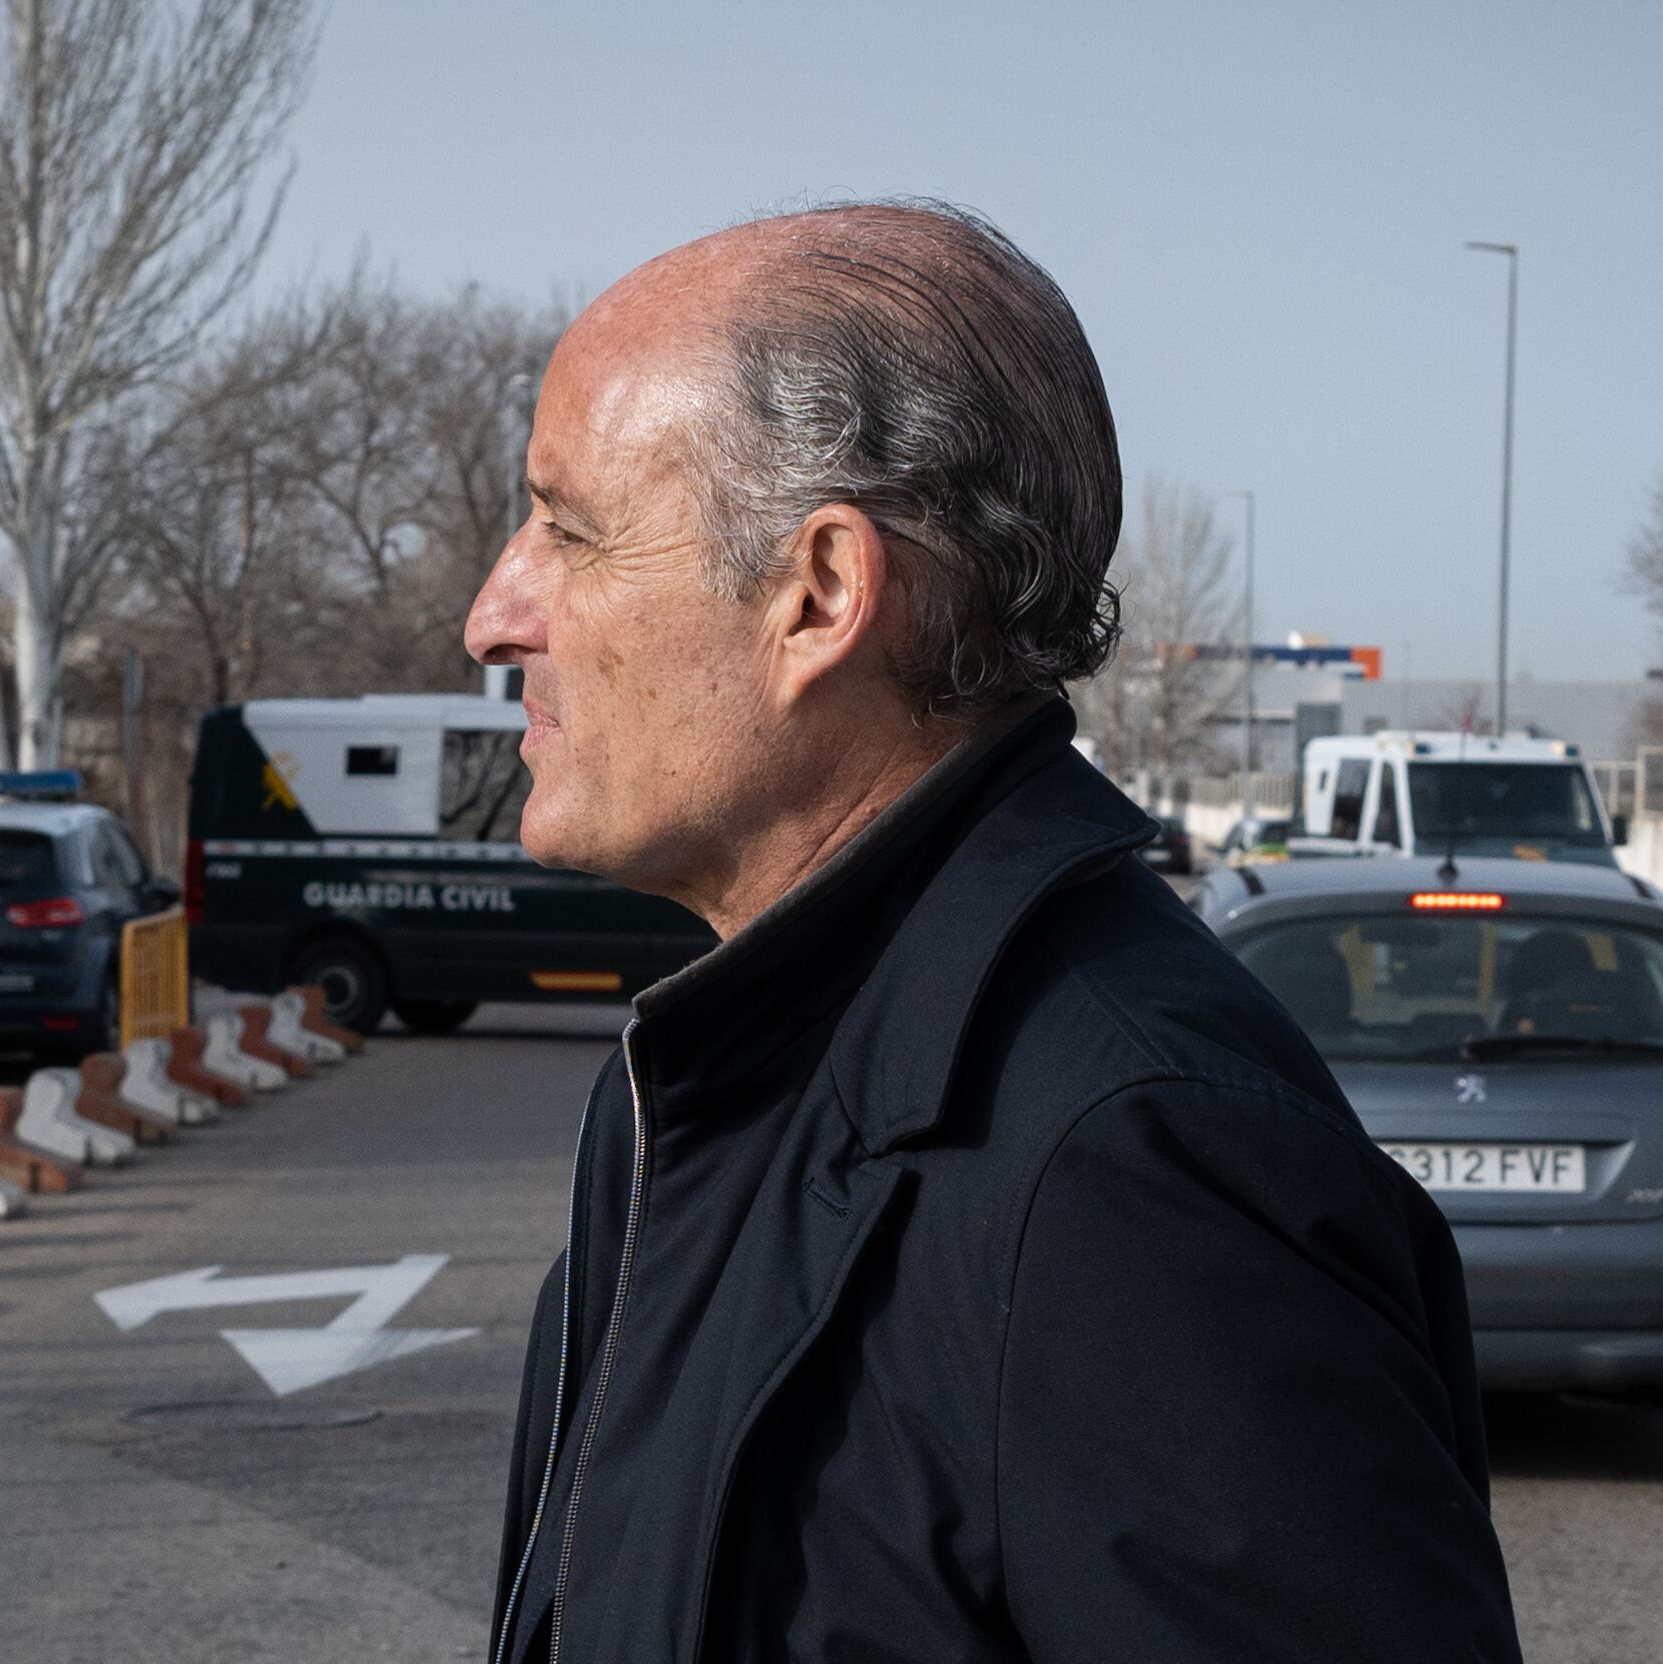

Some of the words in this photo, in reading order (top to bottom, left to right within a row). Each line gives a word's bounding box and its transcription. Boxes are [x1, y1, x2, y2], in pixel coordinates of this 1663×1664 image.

[302, 881, 435, 908] GUARDIA
[441, 885, 515, 912] CIVIL
[1499, 1148, 1572, 1185] FVF
